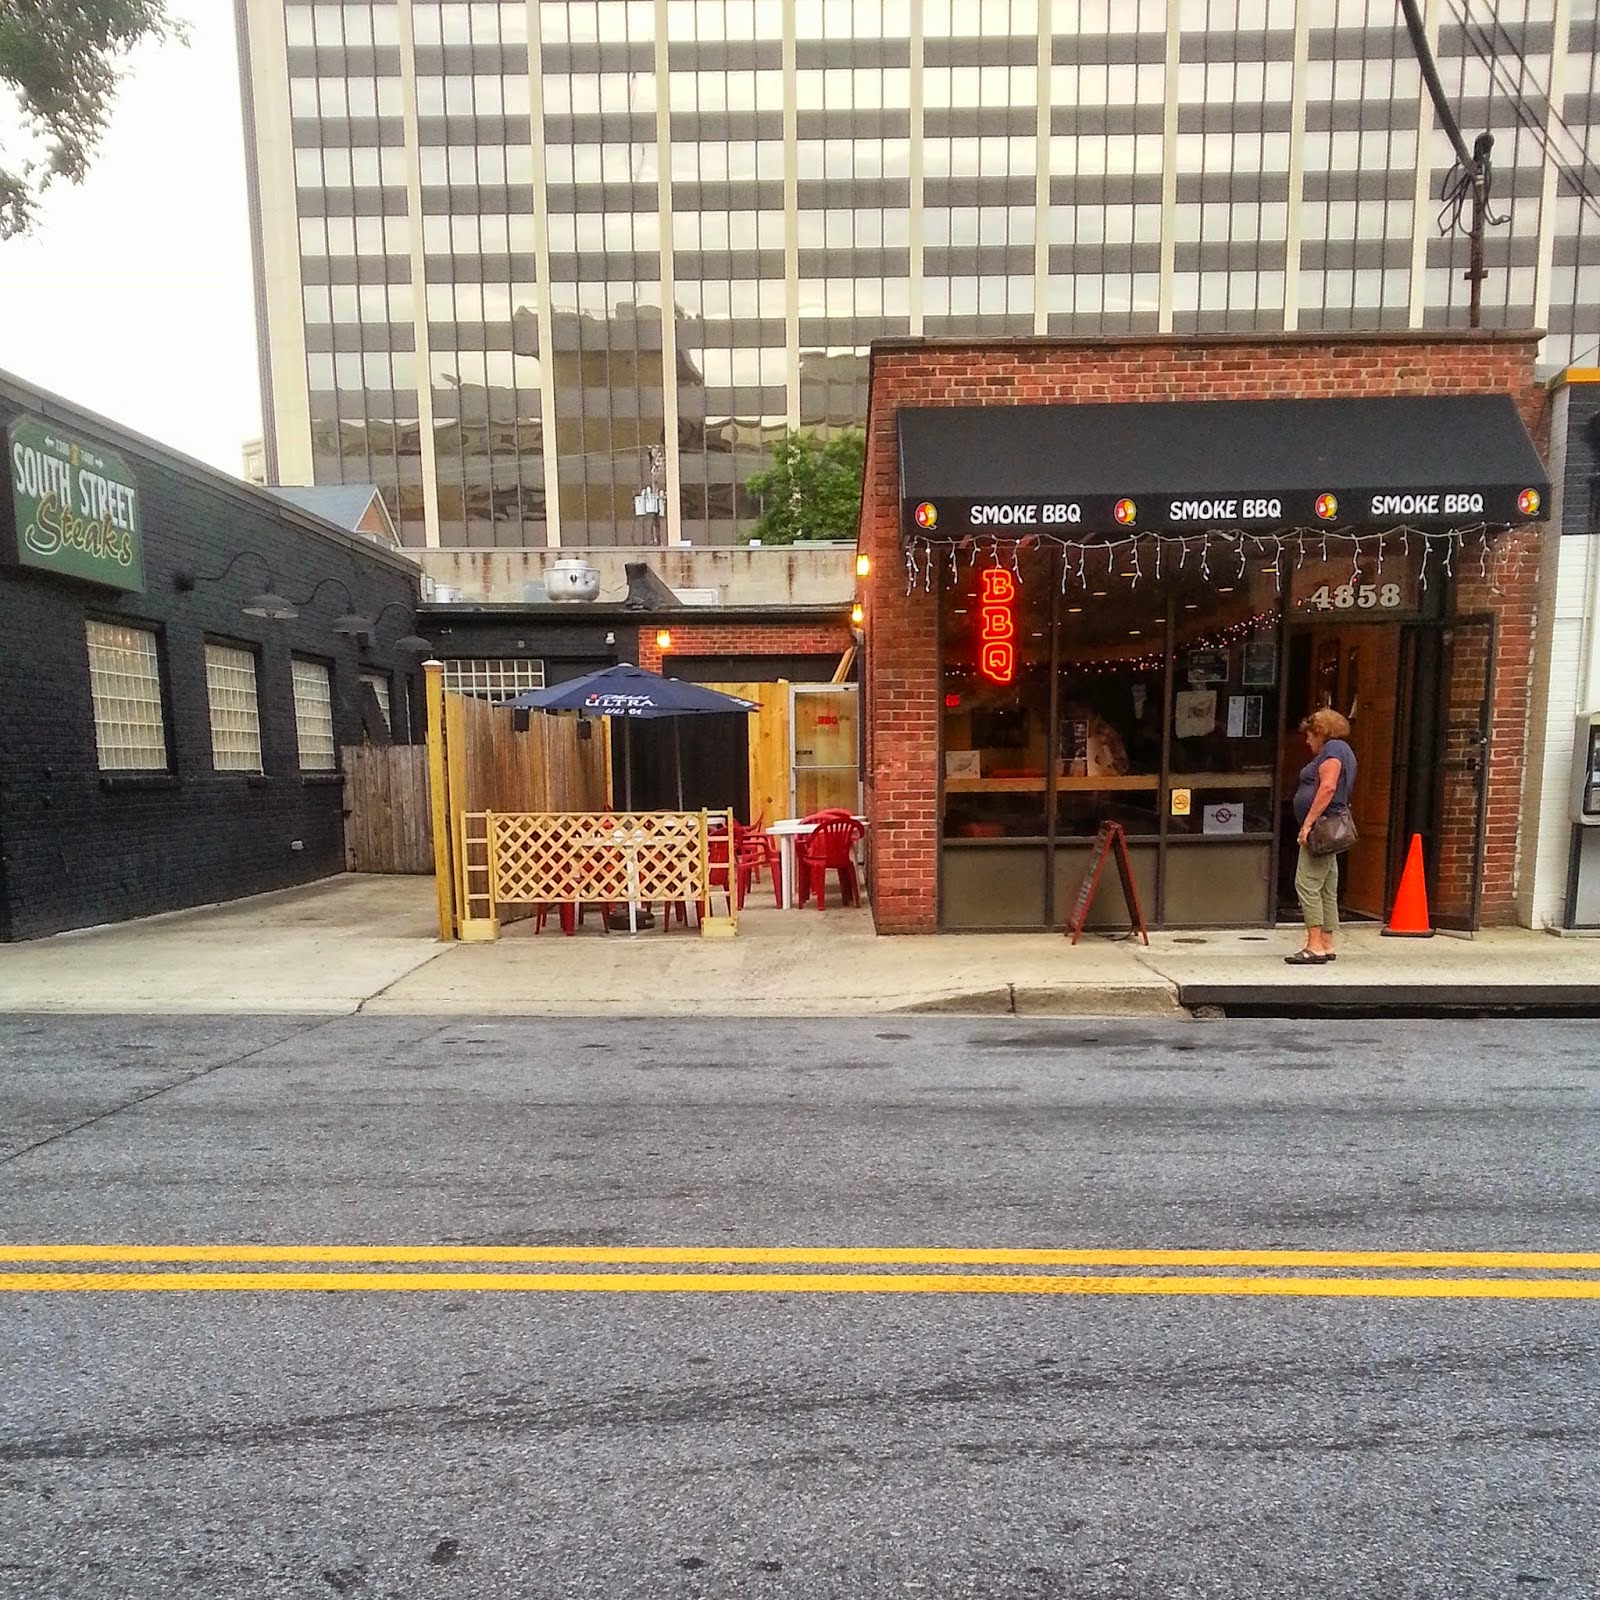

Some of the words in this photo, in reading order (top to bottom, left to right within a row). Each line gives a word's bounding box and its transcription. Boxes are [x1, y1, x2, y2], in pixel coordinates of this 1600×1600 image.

[14, 442, 72, 508] SOUTH
[78, 468, 135, 532] STREET
[969, 504, 1038, 525] SMOKE
[1042, 503, 1082, 524] BBQ
[1169, 500, 1238, 521] SMOKE
[1242, 498, 1282, 519] BBQ
[1371, 494, 1440, 515] SMOKE
[1444, 493, 1484, 513] BBQ
[25, 491, 133, 566] Steaks
[1311, 583, 1401, 609] 4858
[982, 569, 1015, 681] BBQ
[585, 699, 655, 707] ULTRA
